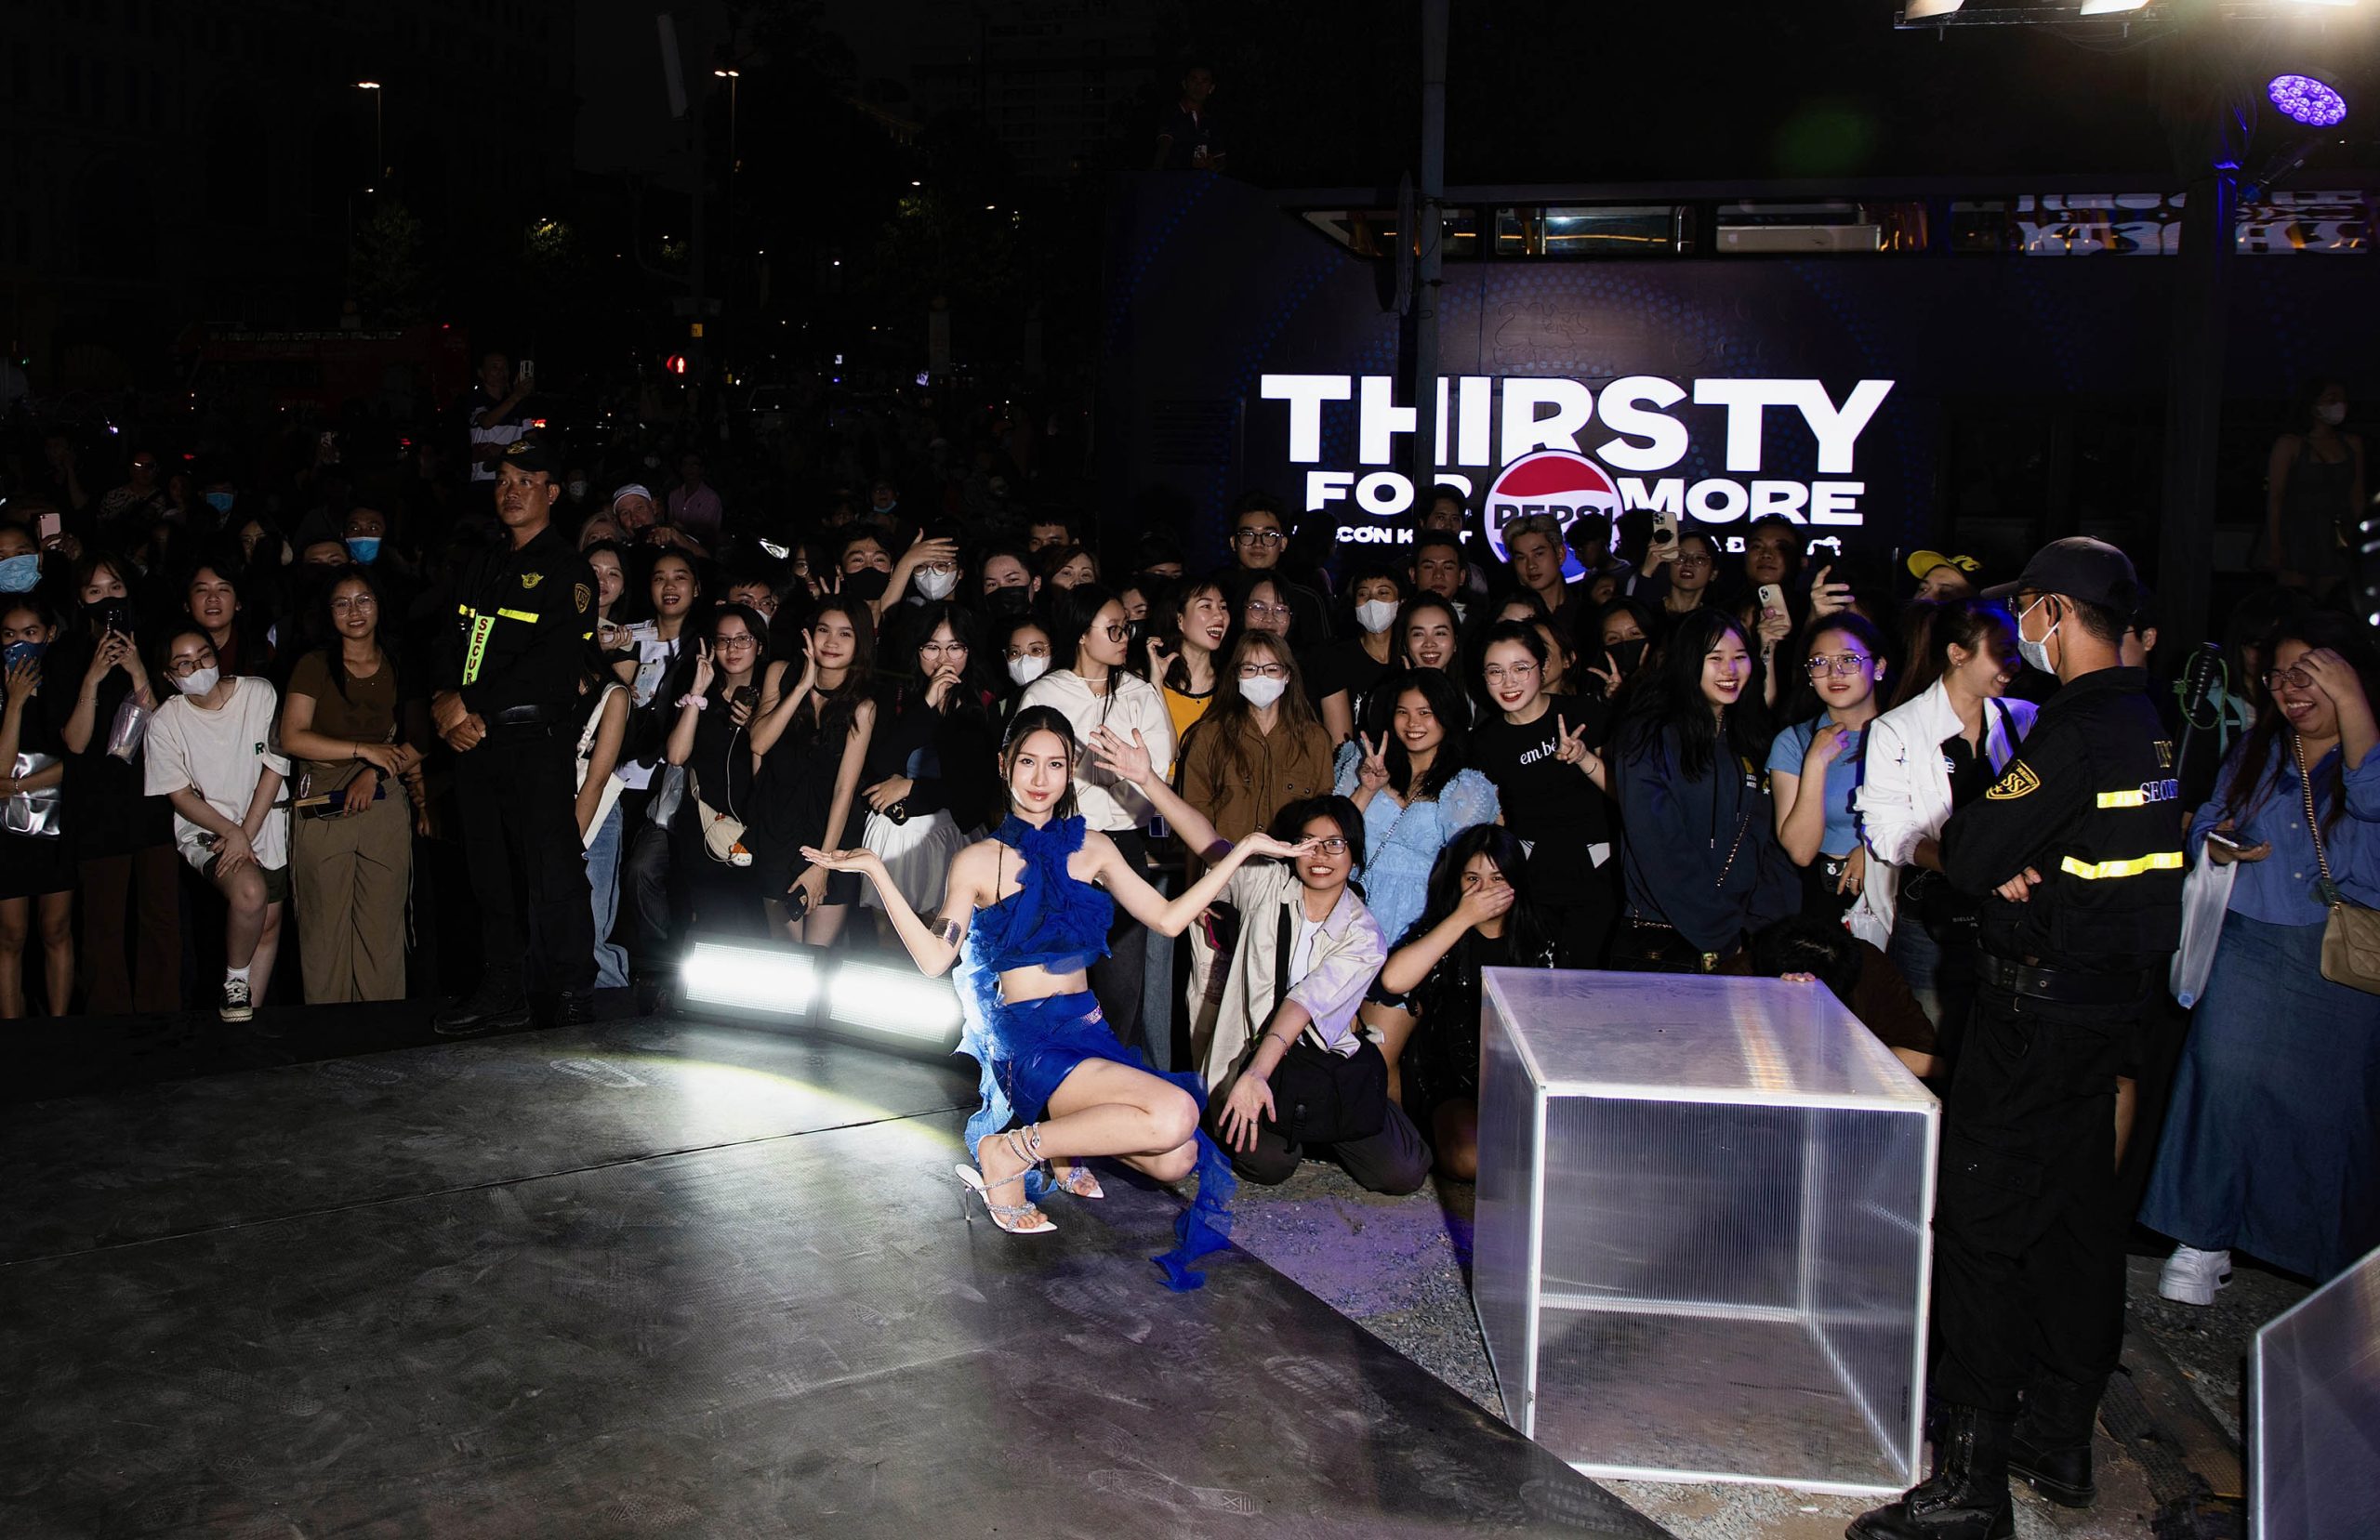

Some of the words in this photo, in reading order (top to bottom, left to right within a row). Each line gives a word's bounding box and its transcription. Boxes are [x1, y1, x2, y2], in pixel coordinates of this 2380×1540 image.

[1261, 375, 1896, 473] THIRSTY
[1617, 478, 1865, 525] MORE
[1520, 749, 1543, 765] em
